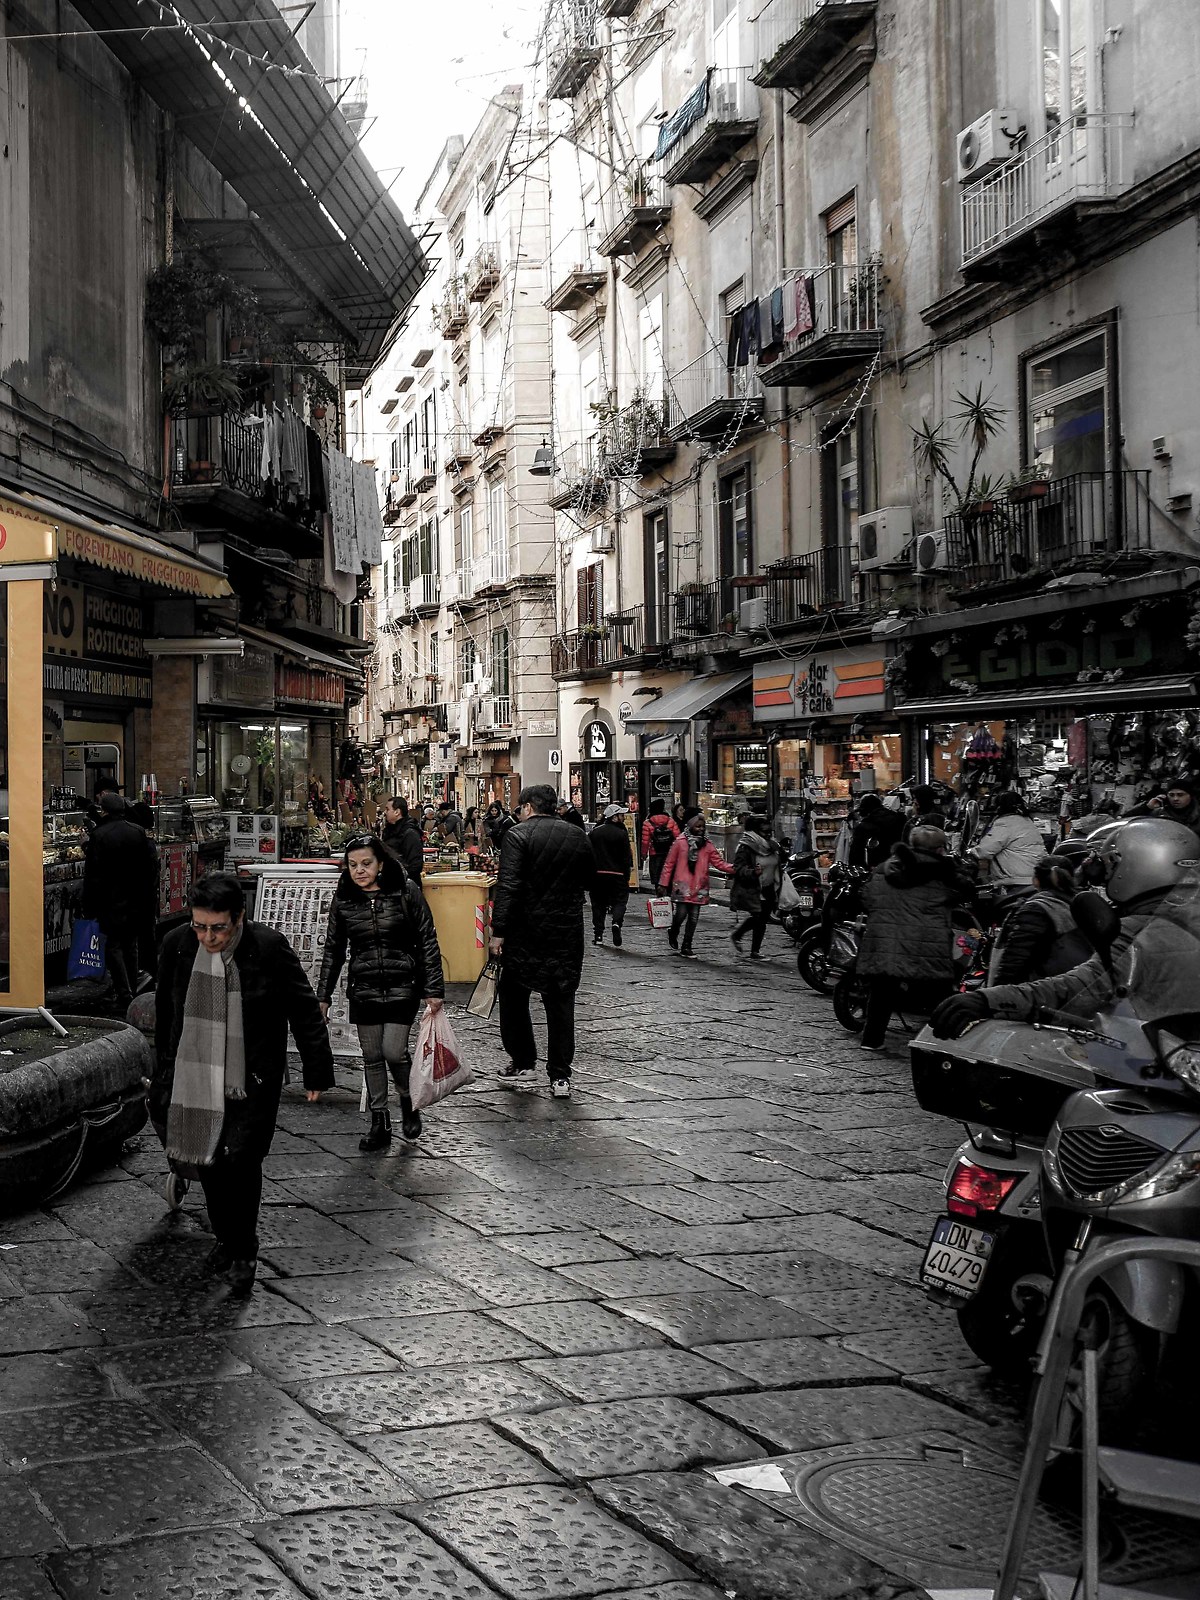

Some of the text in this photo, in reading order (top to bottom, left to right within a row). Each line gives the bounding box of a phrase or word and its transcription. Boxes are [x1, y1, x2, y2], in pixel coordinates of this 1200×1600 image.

[65, 529, 200, 590] FIORENZANO FRIGGITORIA
[86, 595, 144, 630] FRIGGITORI
[809, 658, 828, 681] flor
[941, 628, 1152, 684] EGIDIO
[809, 681, 822, 697] do
[947, 1225, 972, 1250] DN
[928, 1250, 982, 1284] 40479
